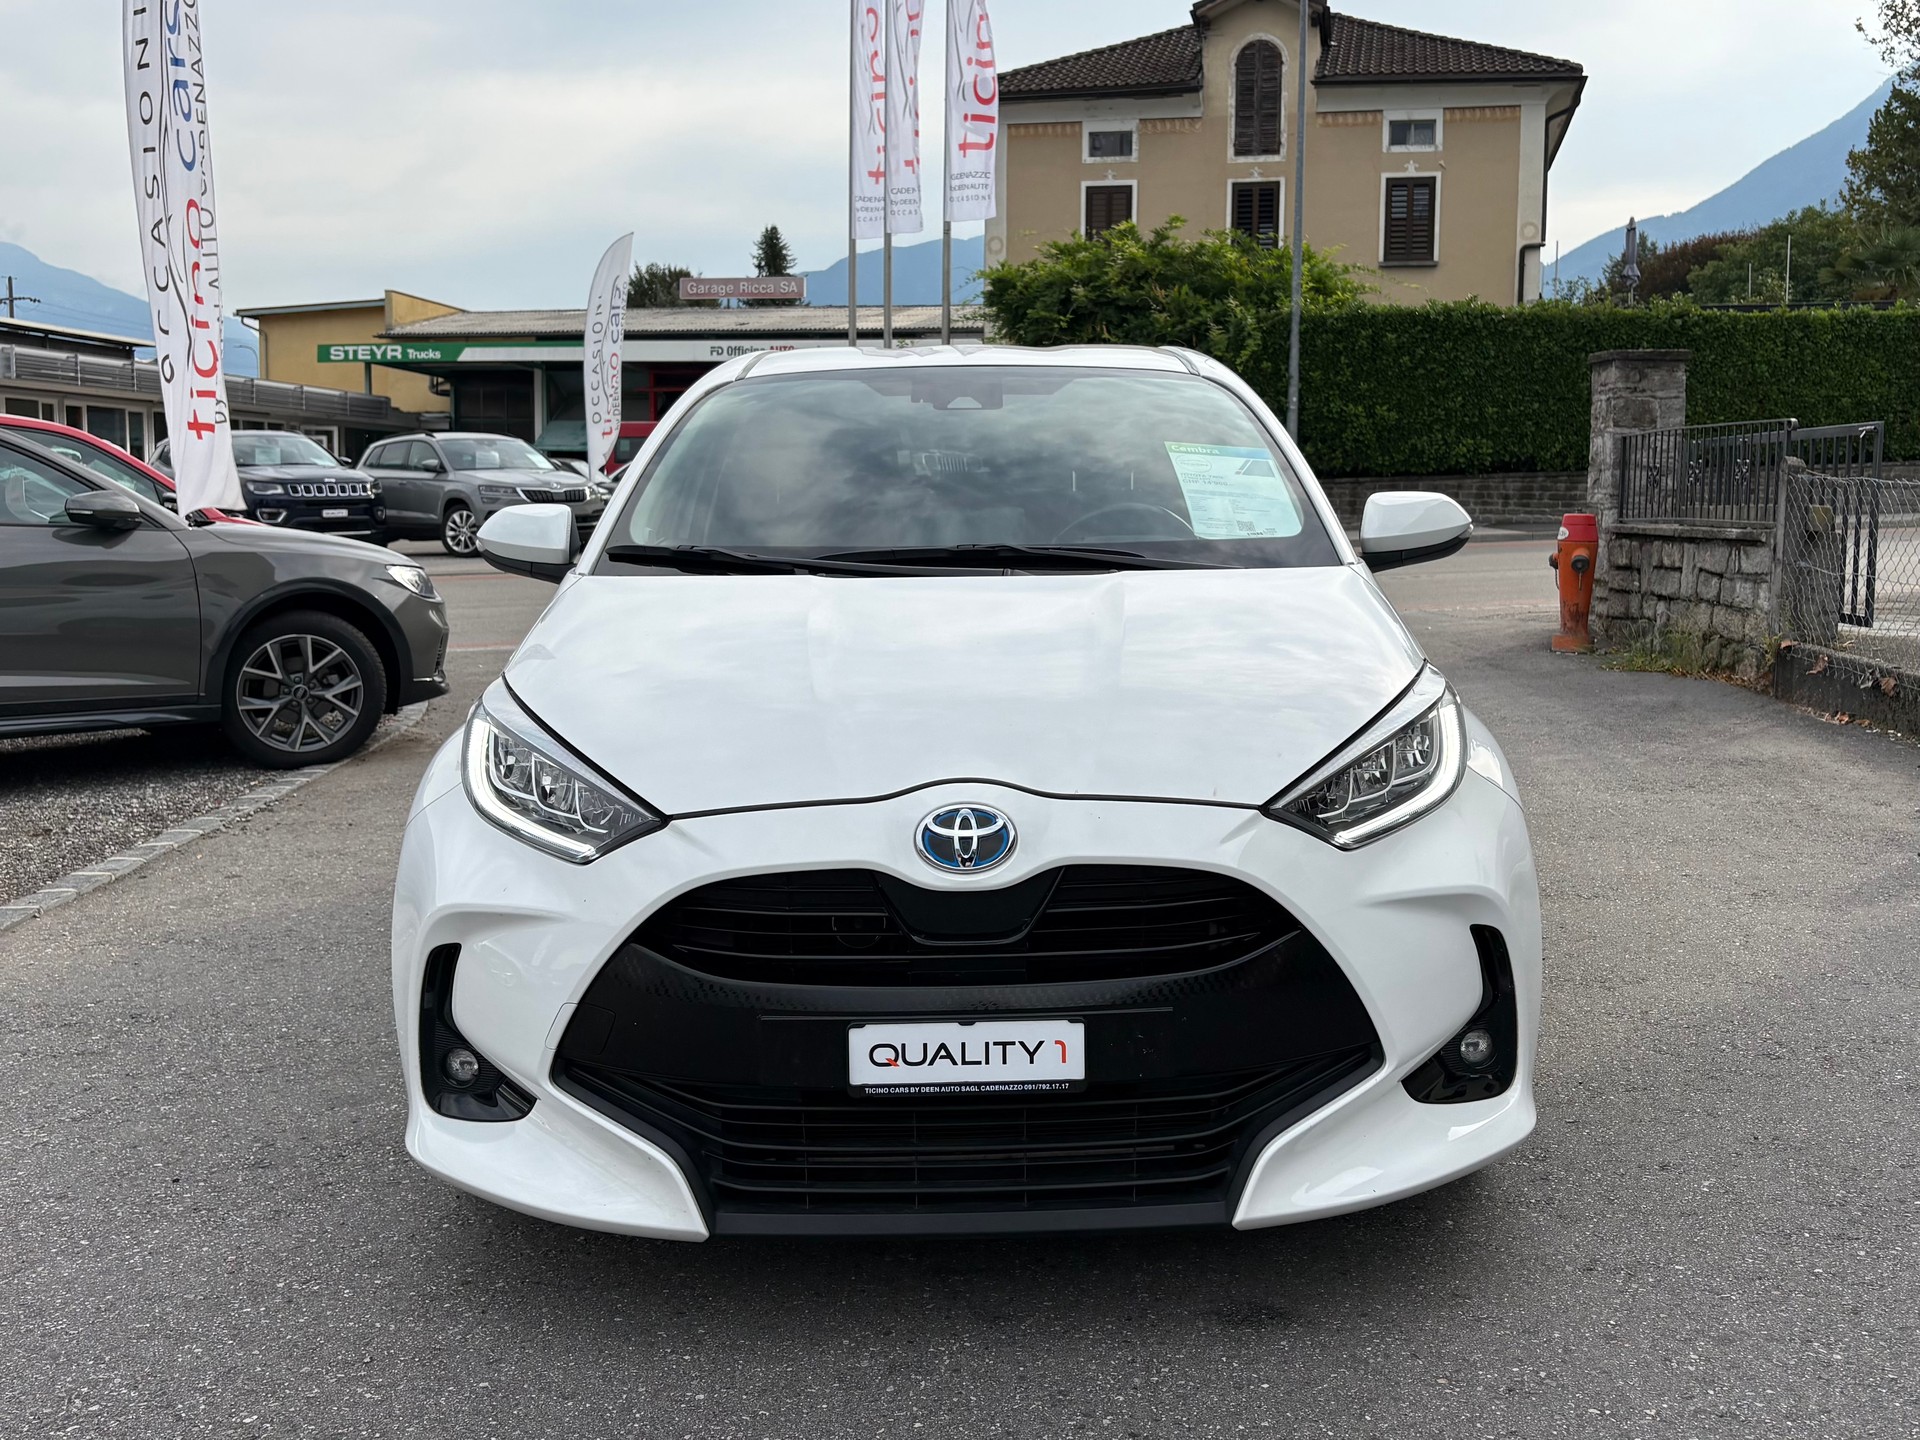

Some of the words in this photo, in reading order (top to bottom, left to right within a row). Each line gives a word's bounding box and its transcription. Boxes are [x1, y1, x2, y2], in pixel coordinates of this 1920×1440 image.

[165, 0, 196, 171] cars
[958, 0, 998, 158] ticin
[687, 281, 734, 296] Garage
[739, 281, 775, 294] Ricca
[779, 281, 798, 293] SA
[329, 345, 402, 360] STEYR
[407, 349, 441, 360] Trucks
[710, 346, 724, 356] FD
[602, 353, 619, 439] tino
[1171, 444, 1220, 455] Cembra
[868, 1040, 1045, 1067] QUALITY
[1054, 1039, 1067, 1064] 1
